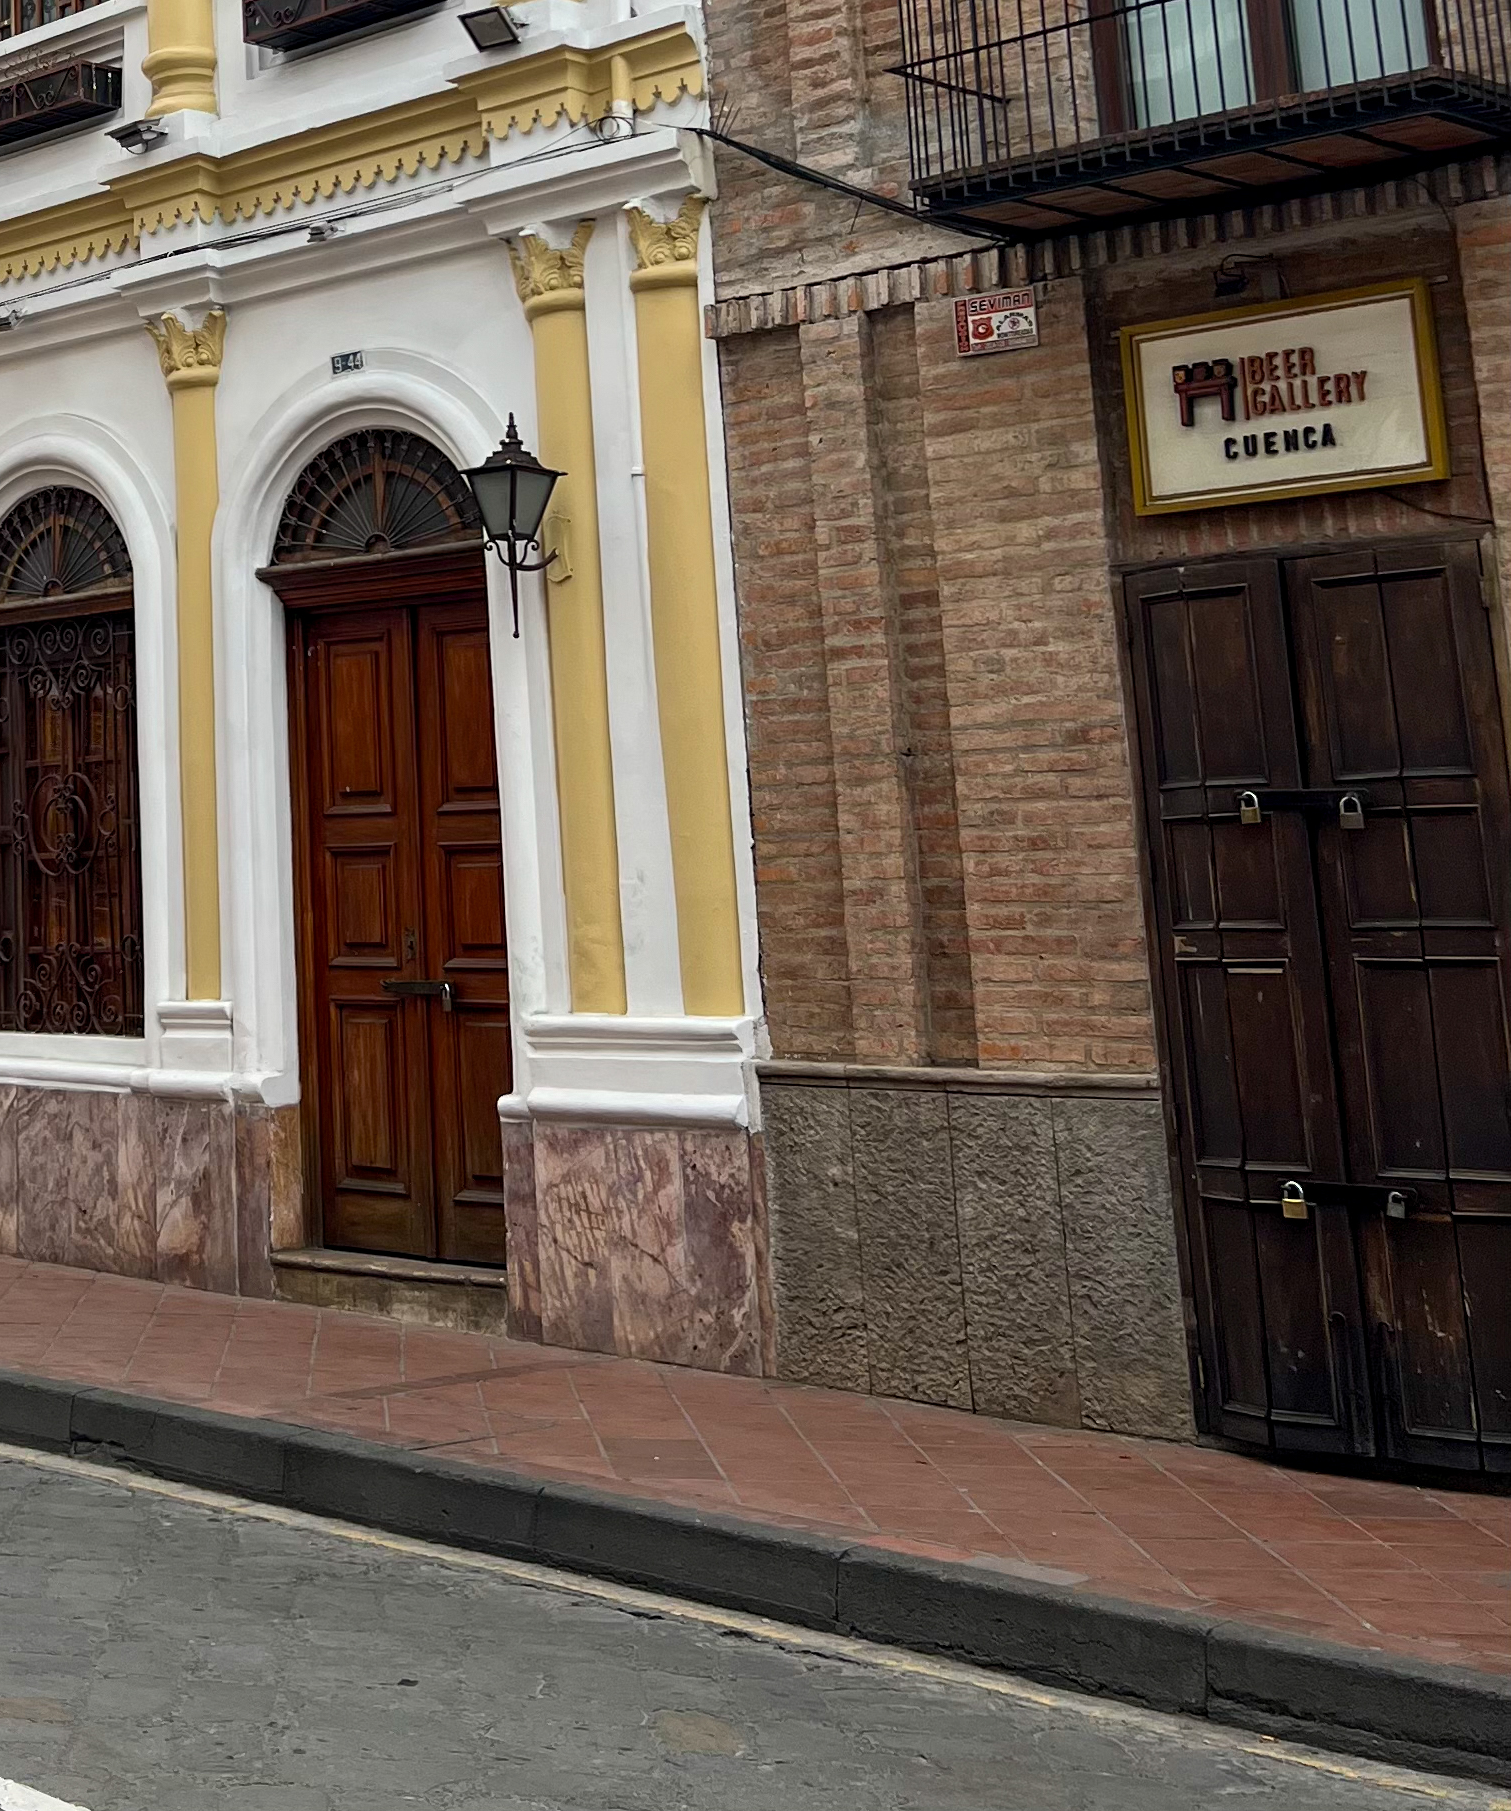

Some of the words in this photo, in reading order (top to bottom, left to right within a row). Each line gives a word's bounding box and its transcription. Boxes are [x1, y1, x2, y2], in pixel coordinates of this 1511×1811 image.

[334, 352, 361, 373] 9-44
[1246, 346, 1316, 385] BEER
[1250, 369, 1367, 416] GALLERY
[1224, 422, 1337, 460] CUENCA
